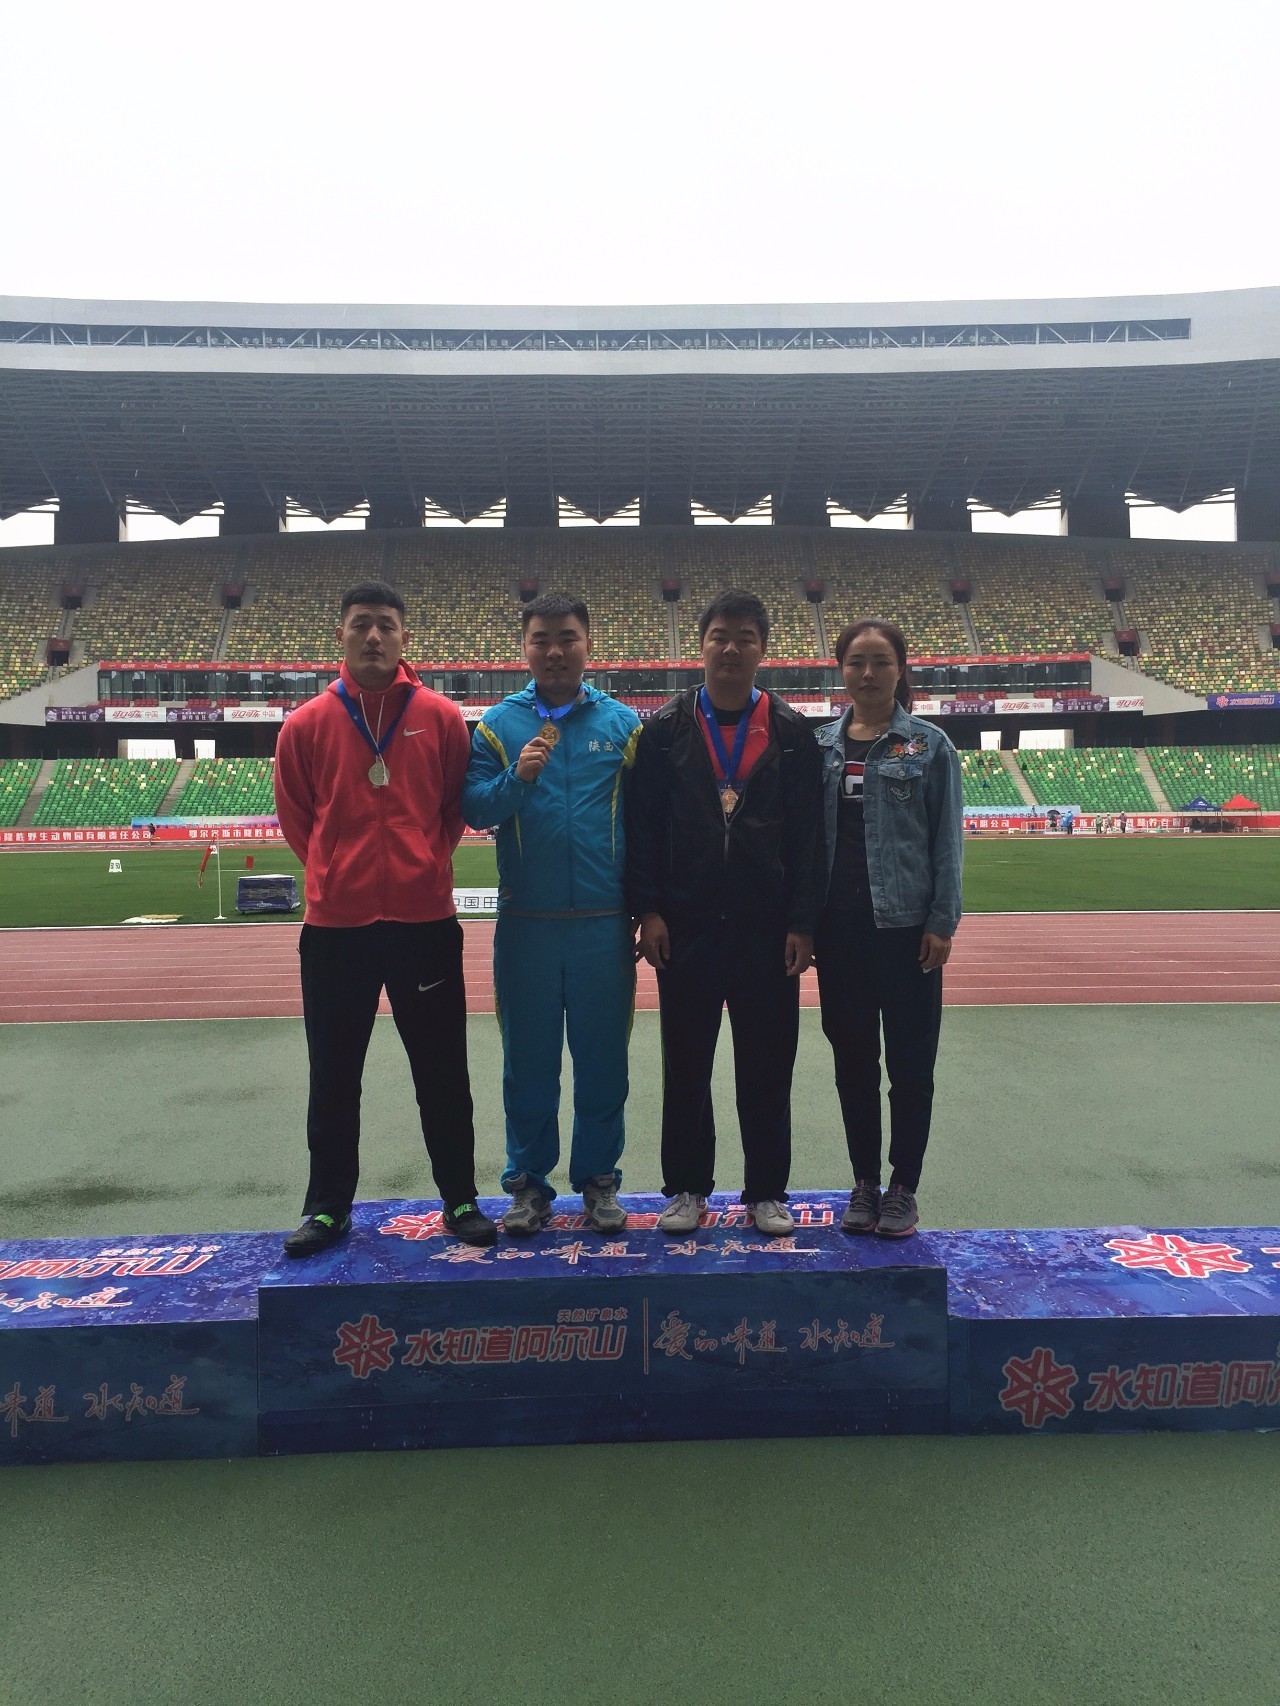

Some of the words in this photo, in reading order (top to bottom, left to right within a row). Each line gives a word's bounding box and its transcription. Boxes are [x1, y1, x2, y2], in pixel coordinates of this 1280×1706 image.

[231, 709, 259, 719] 可口可乐
[588, 740, 614, 752] 陕西
[453, 1203, 472, 1218] NIKE
[664, 1237, 816, 1257] 水知道
[0, 1255, 214, 1280] 阿尔山
[555, 1309, 628, 1323] 天然矿泉水
[404, 1325, 626, 1366] 水知道阿尔山
[652, 1311, 786, 1366] 爱的味道
[799, 1313, 896, 1353] 水知道
[1085, 1361, 1280, 1409] 水知道阿
[84, 1374, 200, 1421] 水知道
